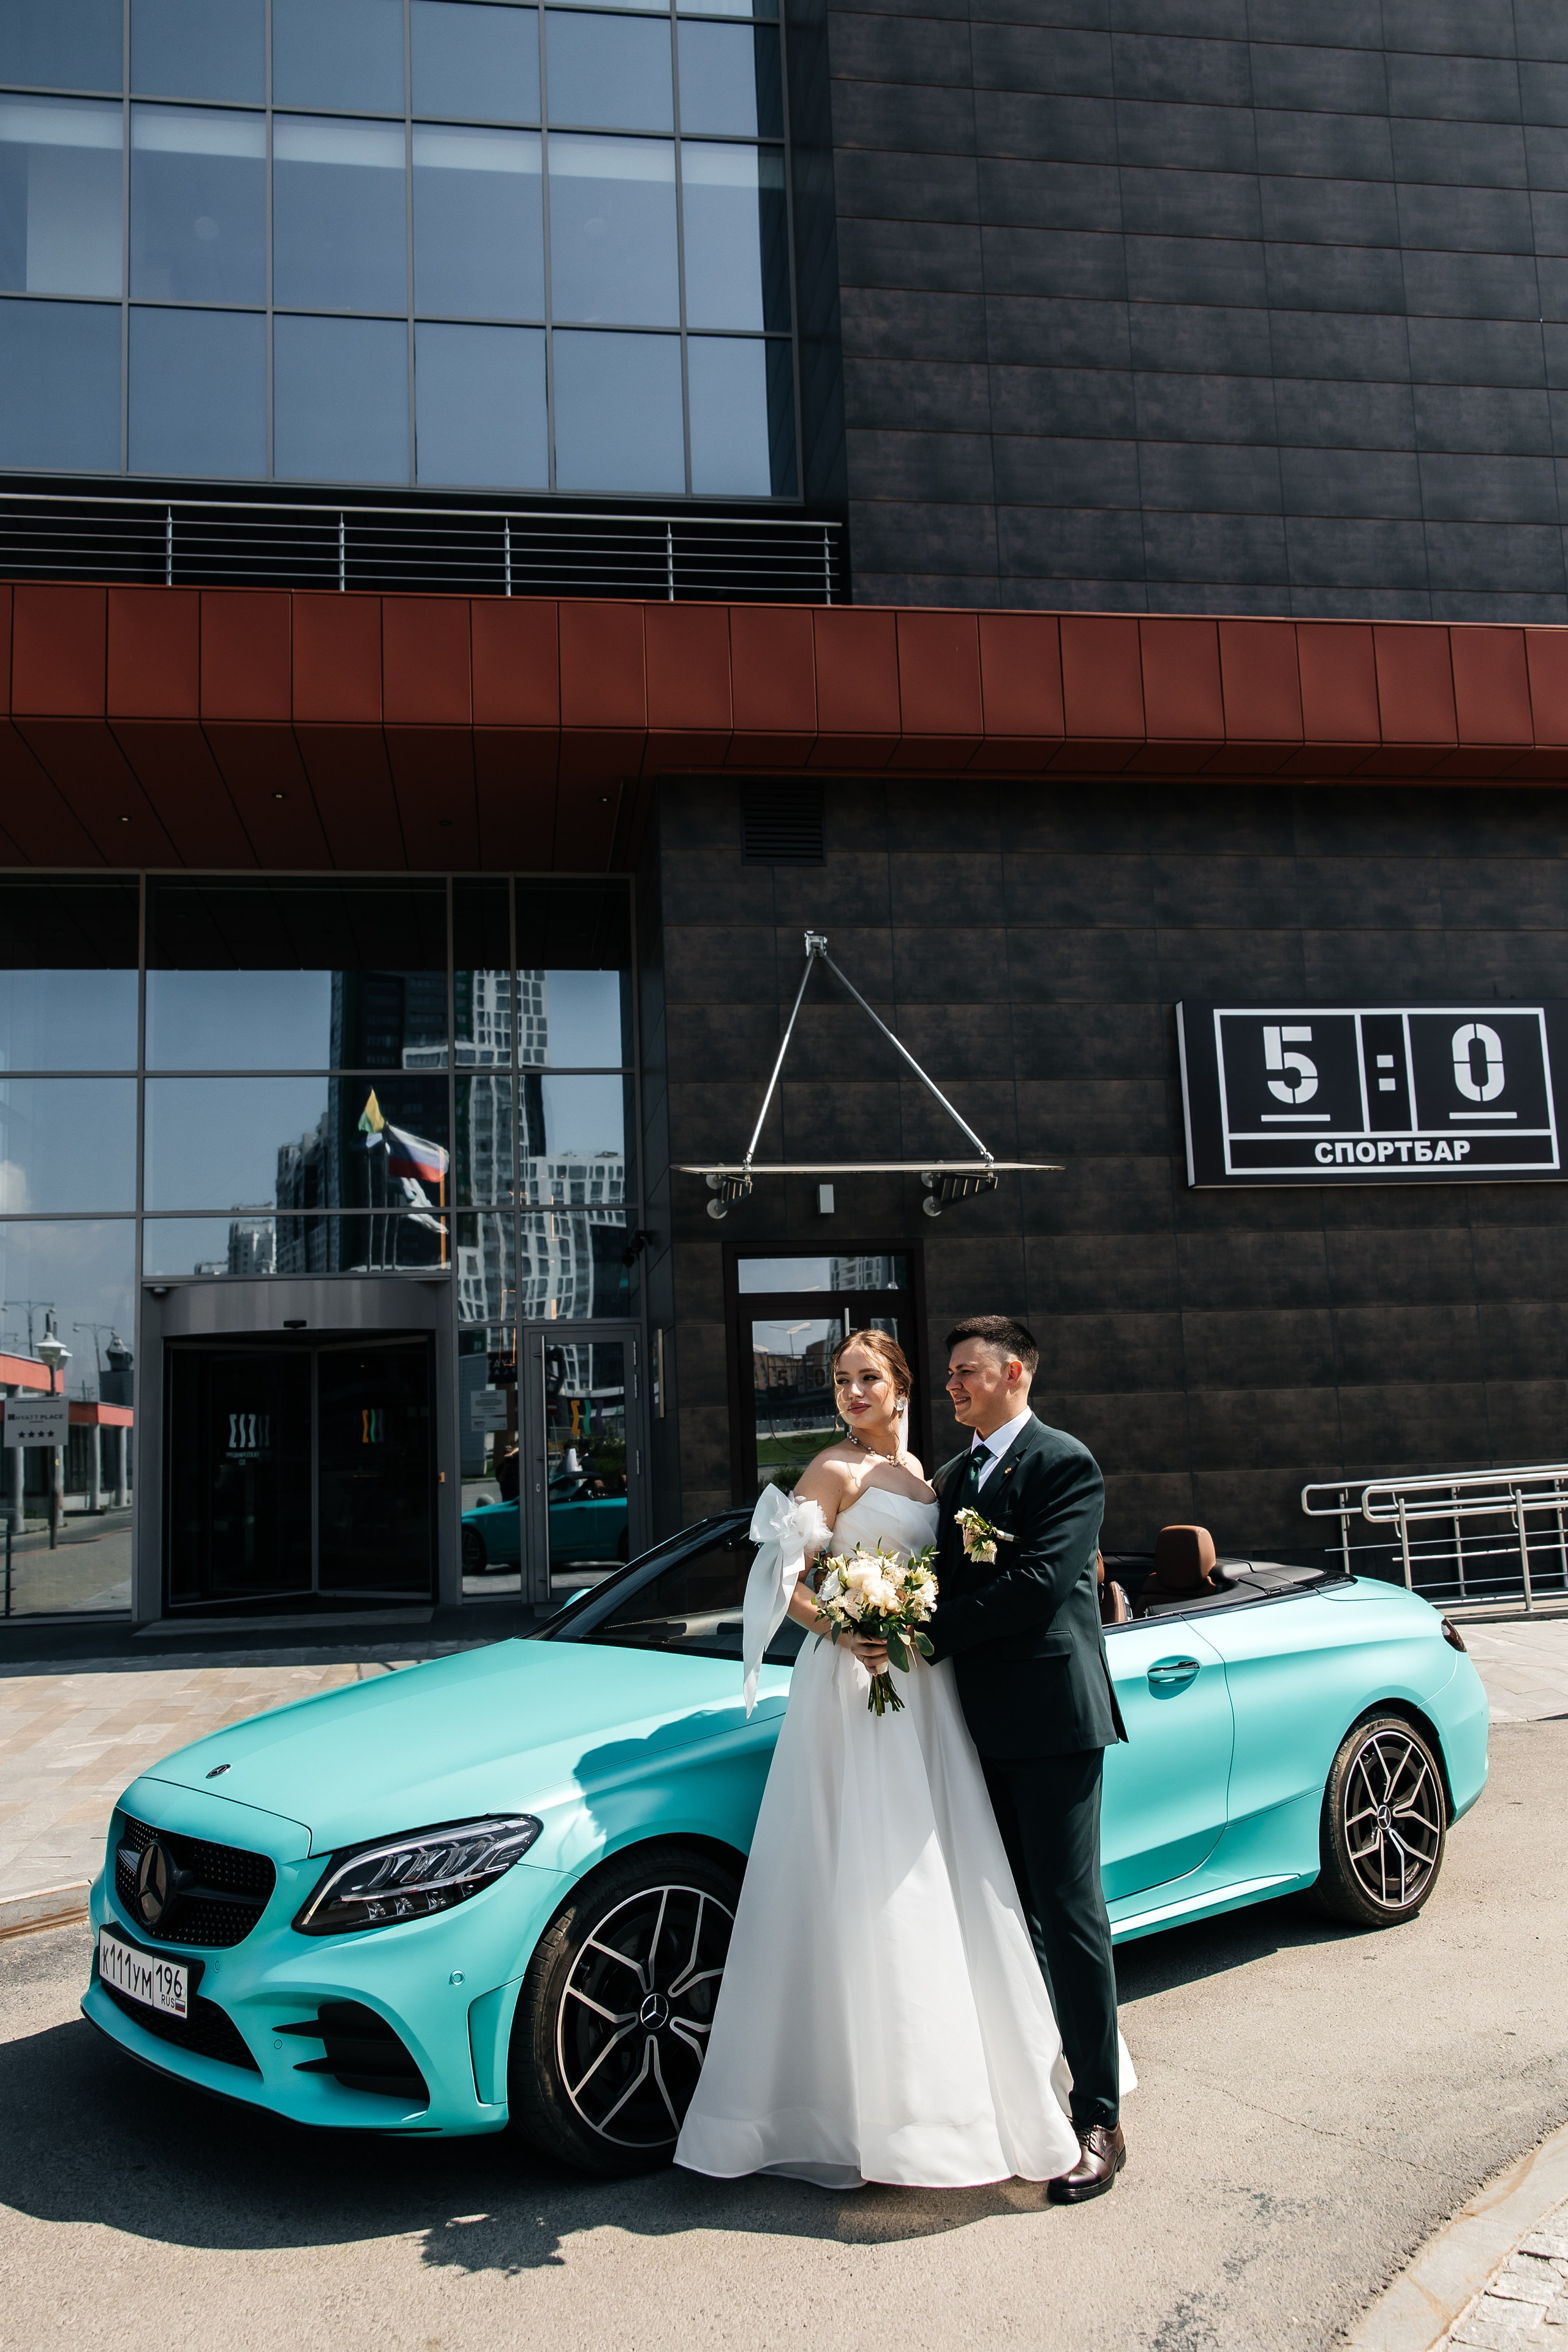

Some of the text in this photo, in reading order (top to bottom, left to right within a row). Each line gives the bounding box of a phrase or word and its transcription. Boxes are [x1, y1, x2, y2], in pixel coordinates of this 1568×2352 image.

[1263, 1026, 1318, 1104] 5
[1314, 1140, 1471, 1163] СПОРТБАР
[156, 1964, 183, 1998] 196
[161, 1994, 175, 2008] RUS
